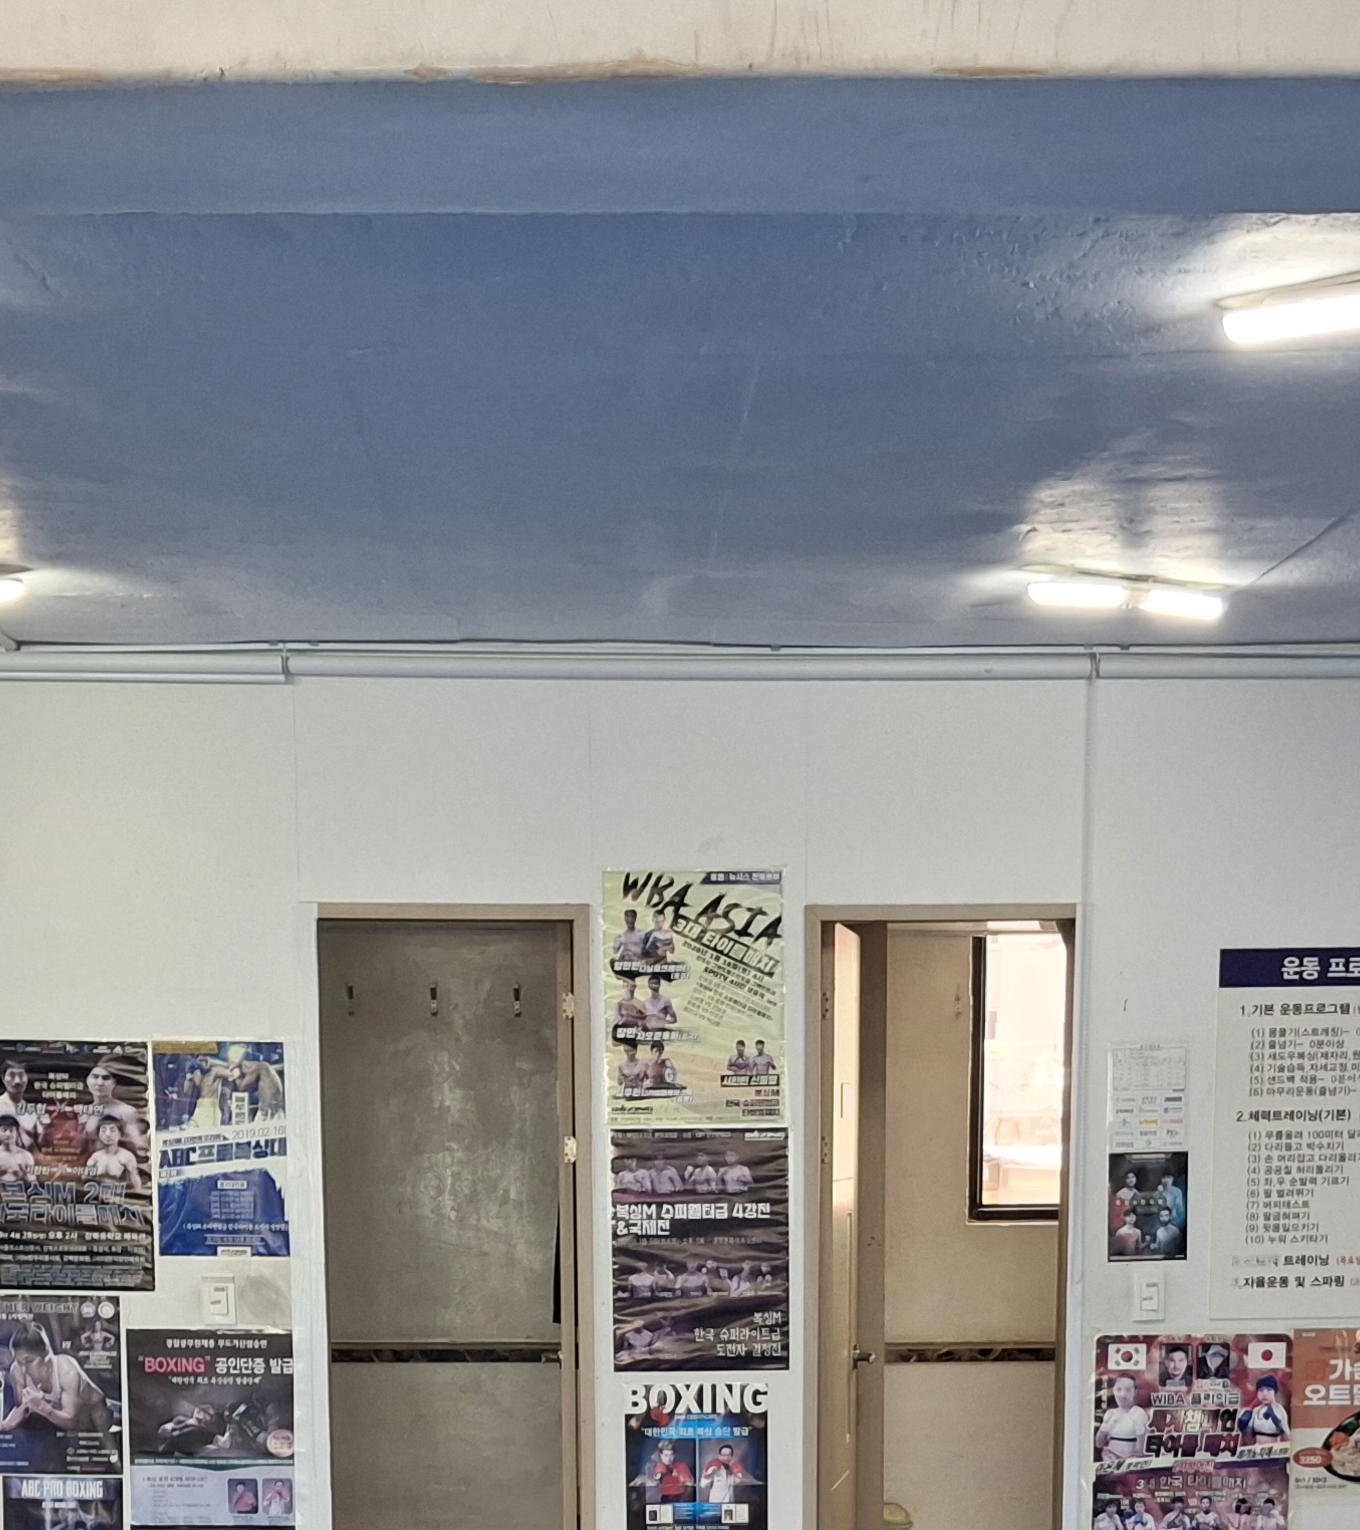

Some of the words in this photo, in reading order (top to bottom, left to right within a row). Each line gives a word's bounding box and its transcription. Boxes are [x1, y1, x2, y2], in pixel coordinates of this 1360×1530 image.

[623, 872, 693, 926] WBA
[695, 892, 783, 948] ASIA
[1281, 957, 1321, 980] 운동
[1279, 1003, 1350, 1016] 운동프로그램
[1251, 1028, 1265, 1038] (1)
[1250, 1040, 1265, 1051] (2)
[1250, 1051, 1265, 1062] (3)
[1249, 1063, 1264, 1074] (4)
[1249, 1075, 1264, 1085] (5)
[1248, 1087, 1264, 1097] (6)
[1248, 1130, 1261, 1141] (1)
[1307, 1129, 1343, 1140] 100미터
[1248, 1142, 1261, 1152] (2)
[1265, 1142, 1302, 1152] 다리들고
[1306, 1141, 1344, 1151] 박수치기
[1247, 1154, 1261, 1164] (3)
[1264, 1153, 1274, 1164] 손
[1277, 1153, 1315, 1163] 머리잡고
[1247, 1165, 1260, 1176] (4)
[1296, 1164, 1344, 1175] 허리돌리기
[1247, 1177, 1260, 1188] (5)
[1289, 1176, 1318, 1186] 순발력
[1321, 1175, 1350, 1186] 기르기
[0, 1181, 76, 1203] 복싱M
[84, 1181, 127, 1203] 2대
[1246, 1188, 1260, 1199] (6)
[1246, 1200, 1260, 1210] (7)
[1263, 1200, 1310, 1210] 버피테스트
[616, 1204, 657, 1220] 복싱M
[660, 1203, 728, 1220] 슈퍼웰터급
[732, 1203, 771, 1219] 4강전
[1246, 1211, 1259, 1222] (8)
[1245, 1223, 1259, 1234] (9)
[1245, 1234, 1265, 1245] (10)
[1268, 1234, 1287, 1245] 누워
[1290, 1233, 1329, 1244] 스키타기
[1283, 1254, 1330, 1267] 트레이닝
[1294, 1275, 1306, 1288] 및
[1311, 1275, 1345, 1288] 스파링
[31, 1303, 80, 1314] WEIGHT
[753, 1312, 782, 1325] 복싱M
[693, 1328, 715, 1342] 한국
[716, 1343, 747, 1357] 도전자
[214, 1357, 266, 1375] 공인단증
[269, 1357, 293, 1375] 발급
[625, 1382, 768, 1415] BOXING
[1151, 1392, 1186, 1406] WIBA
[21, 1479, 41, 1498] ABC
[43, 1480, 64, 1498] PRO
[66, 1480, 104, 1499] BOXING
[1159, 1476, 1183, 1490] 한국
